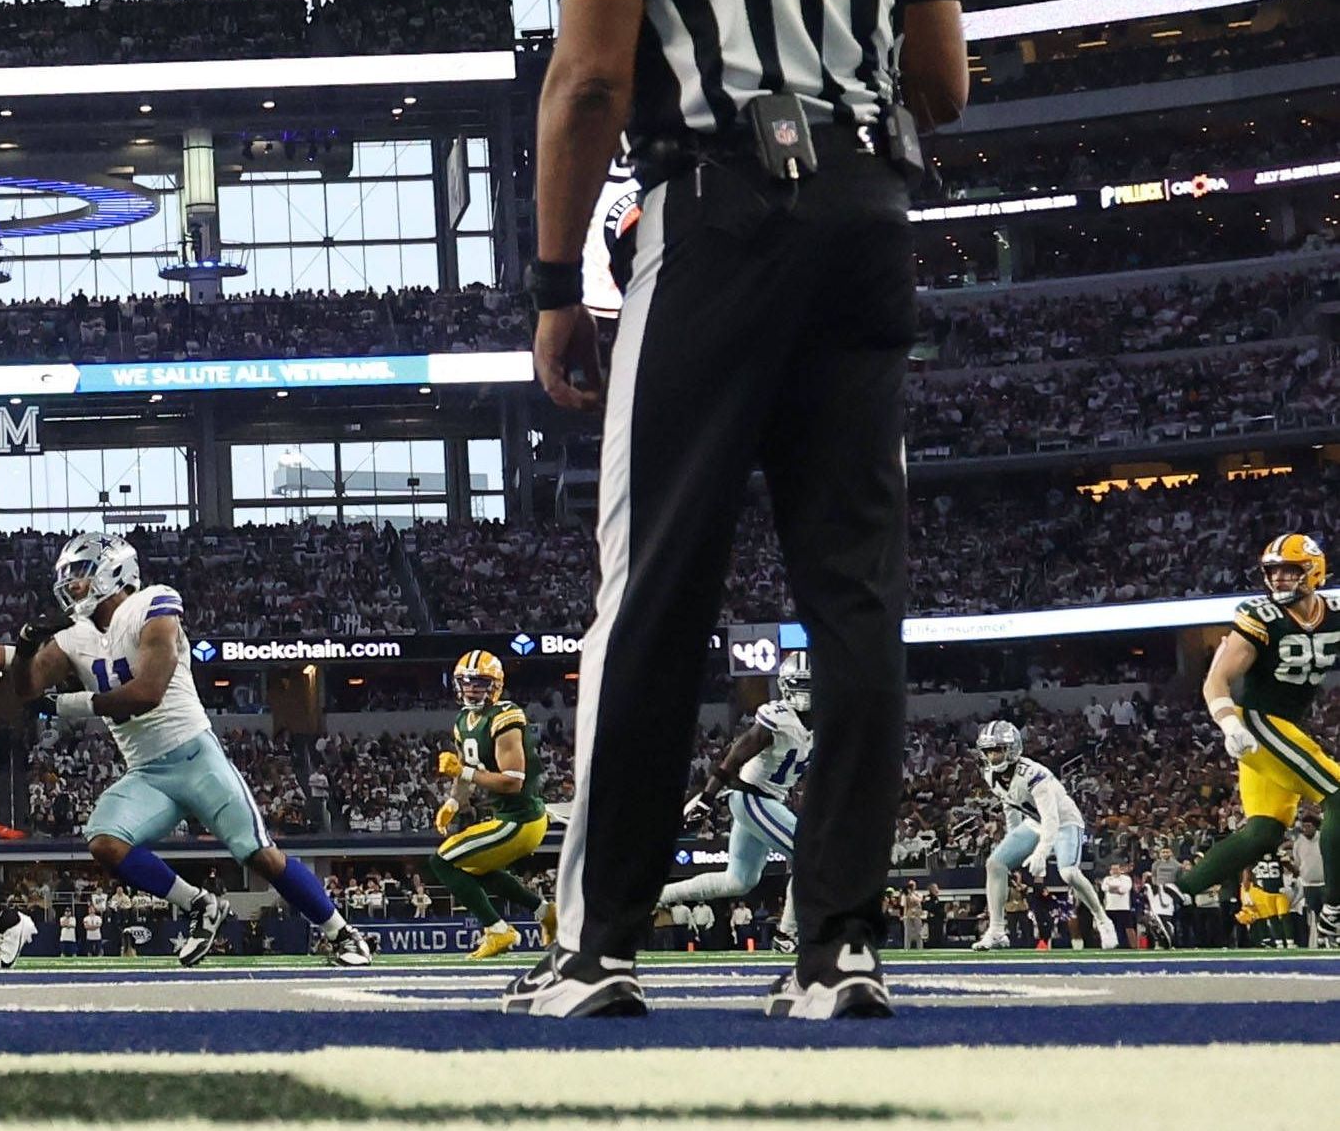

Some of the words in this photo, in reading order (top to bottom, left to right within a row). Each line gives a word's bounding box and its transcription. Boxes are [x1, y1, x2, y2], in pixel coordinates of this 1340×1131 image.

[111, 368, 148, 386] WE
[151, 365, 232, 385] SALUTE
[234, 364, 277, 383] ALL
[222, 639, 401, 662] Blockchain.com
[731, 638, 777, 672] 40
[1273, 631, 1340, 686] 85
[90, 656, 136, 693] 11
[388, 930, 447, 951] WILD
